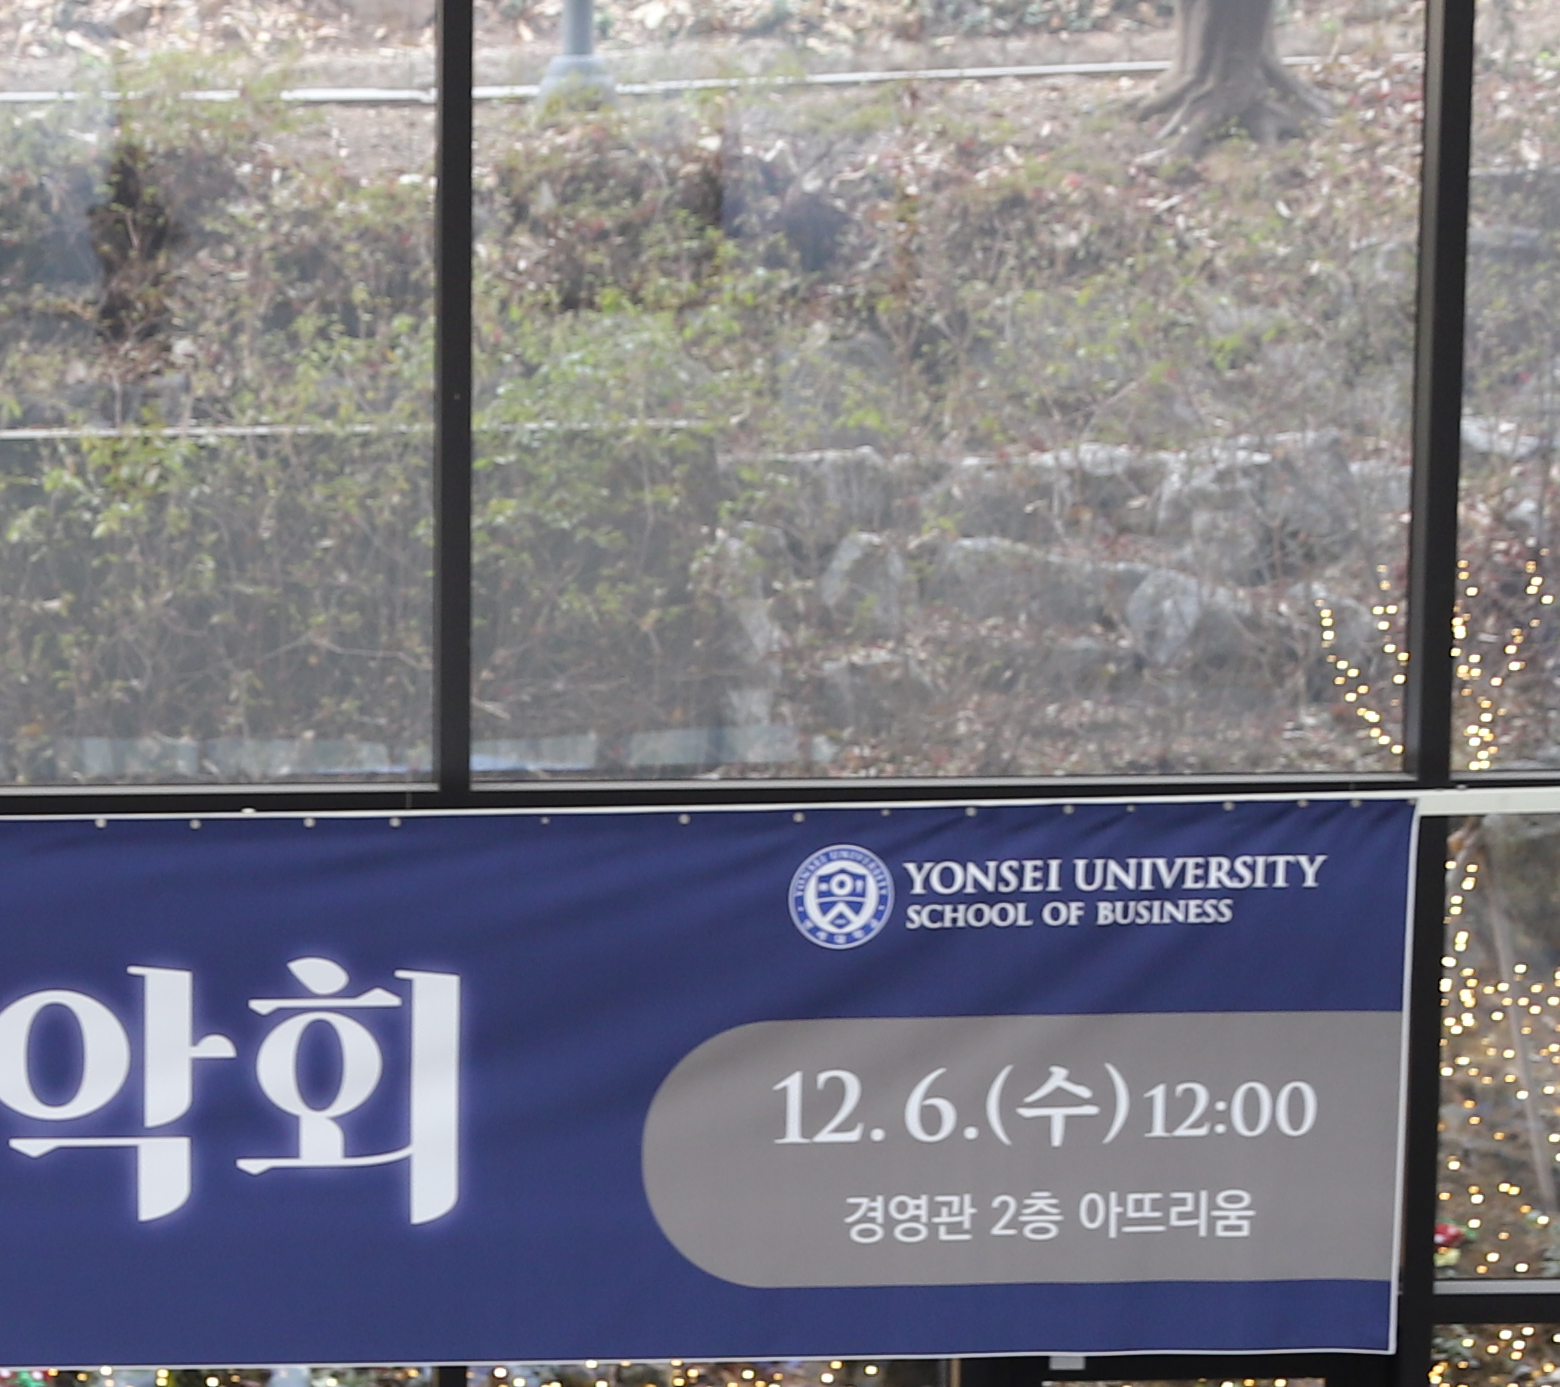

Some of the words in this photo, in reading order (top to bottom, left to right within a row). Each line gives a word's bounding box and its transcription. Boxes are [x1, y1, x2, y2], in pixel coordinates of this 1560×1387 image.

[903, 860, 1061, 896] YONSEI
[1072, 853, 1329, 894] UNIVERSITY
[906, 899, 1033, 930] SCHOOL
[1041, 900, 1085, 927] OF
[1096, 897, 1234, 925] BUSINESS
[1145, 1078, 1318, 1140] 12:00
[844, 1193, 976, 1244] 경영관
[990, 1192, 1064, 1243] 2층
[1079, 1189, 1256, 1243] 아뜨리움
